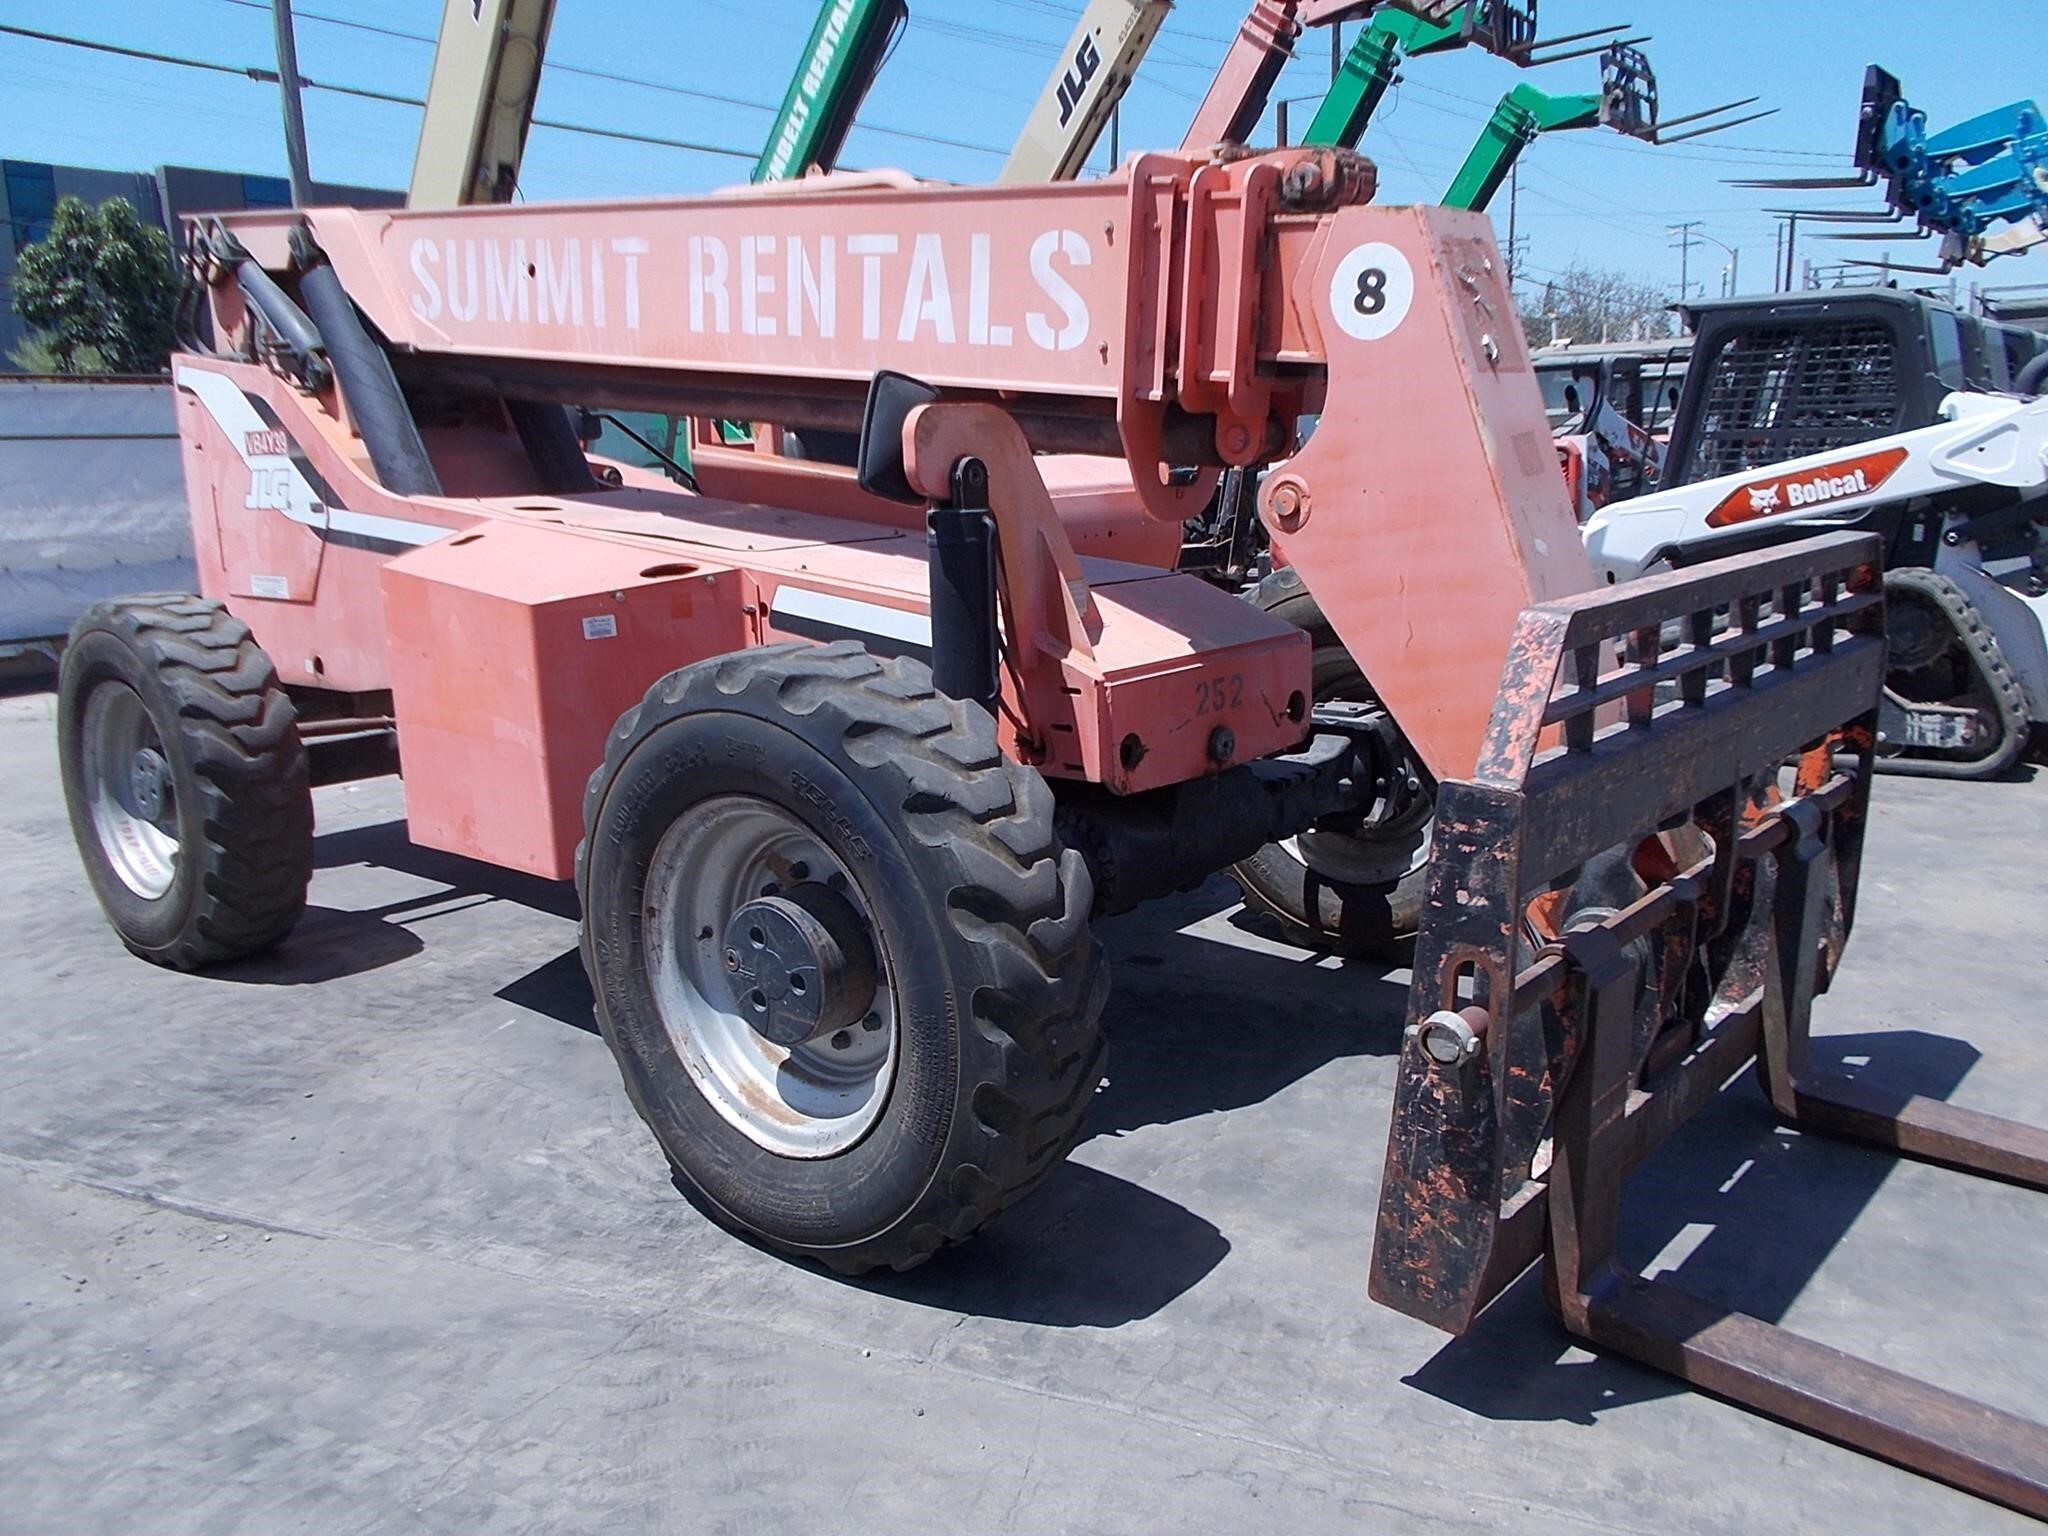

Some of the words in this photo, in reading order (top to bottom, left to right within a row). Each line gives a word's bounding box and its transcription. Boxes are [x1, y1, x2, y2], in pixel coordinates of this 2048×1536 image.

[1055, 30, 1101, 130] JLG
[410, 237, 649, 329] SUMMIT
[688, 229, 1092, 351] RENTALS
[1354, 267, 1387, 315] 8
[244, 469, 288, 510] JLG
[1785, 468, 1868, 507] Bobcat
[1196, 674, 1244, 717] 252
